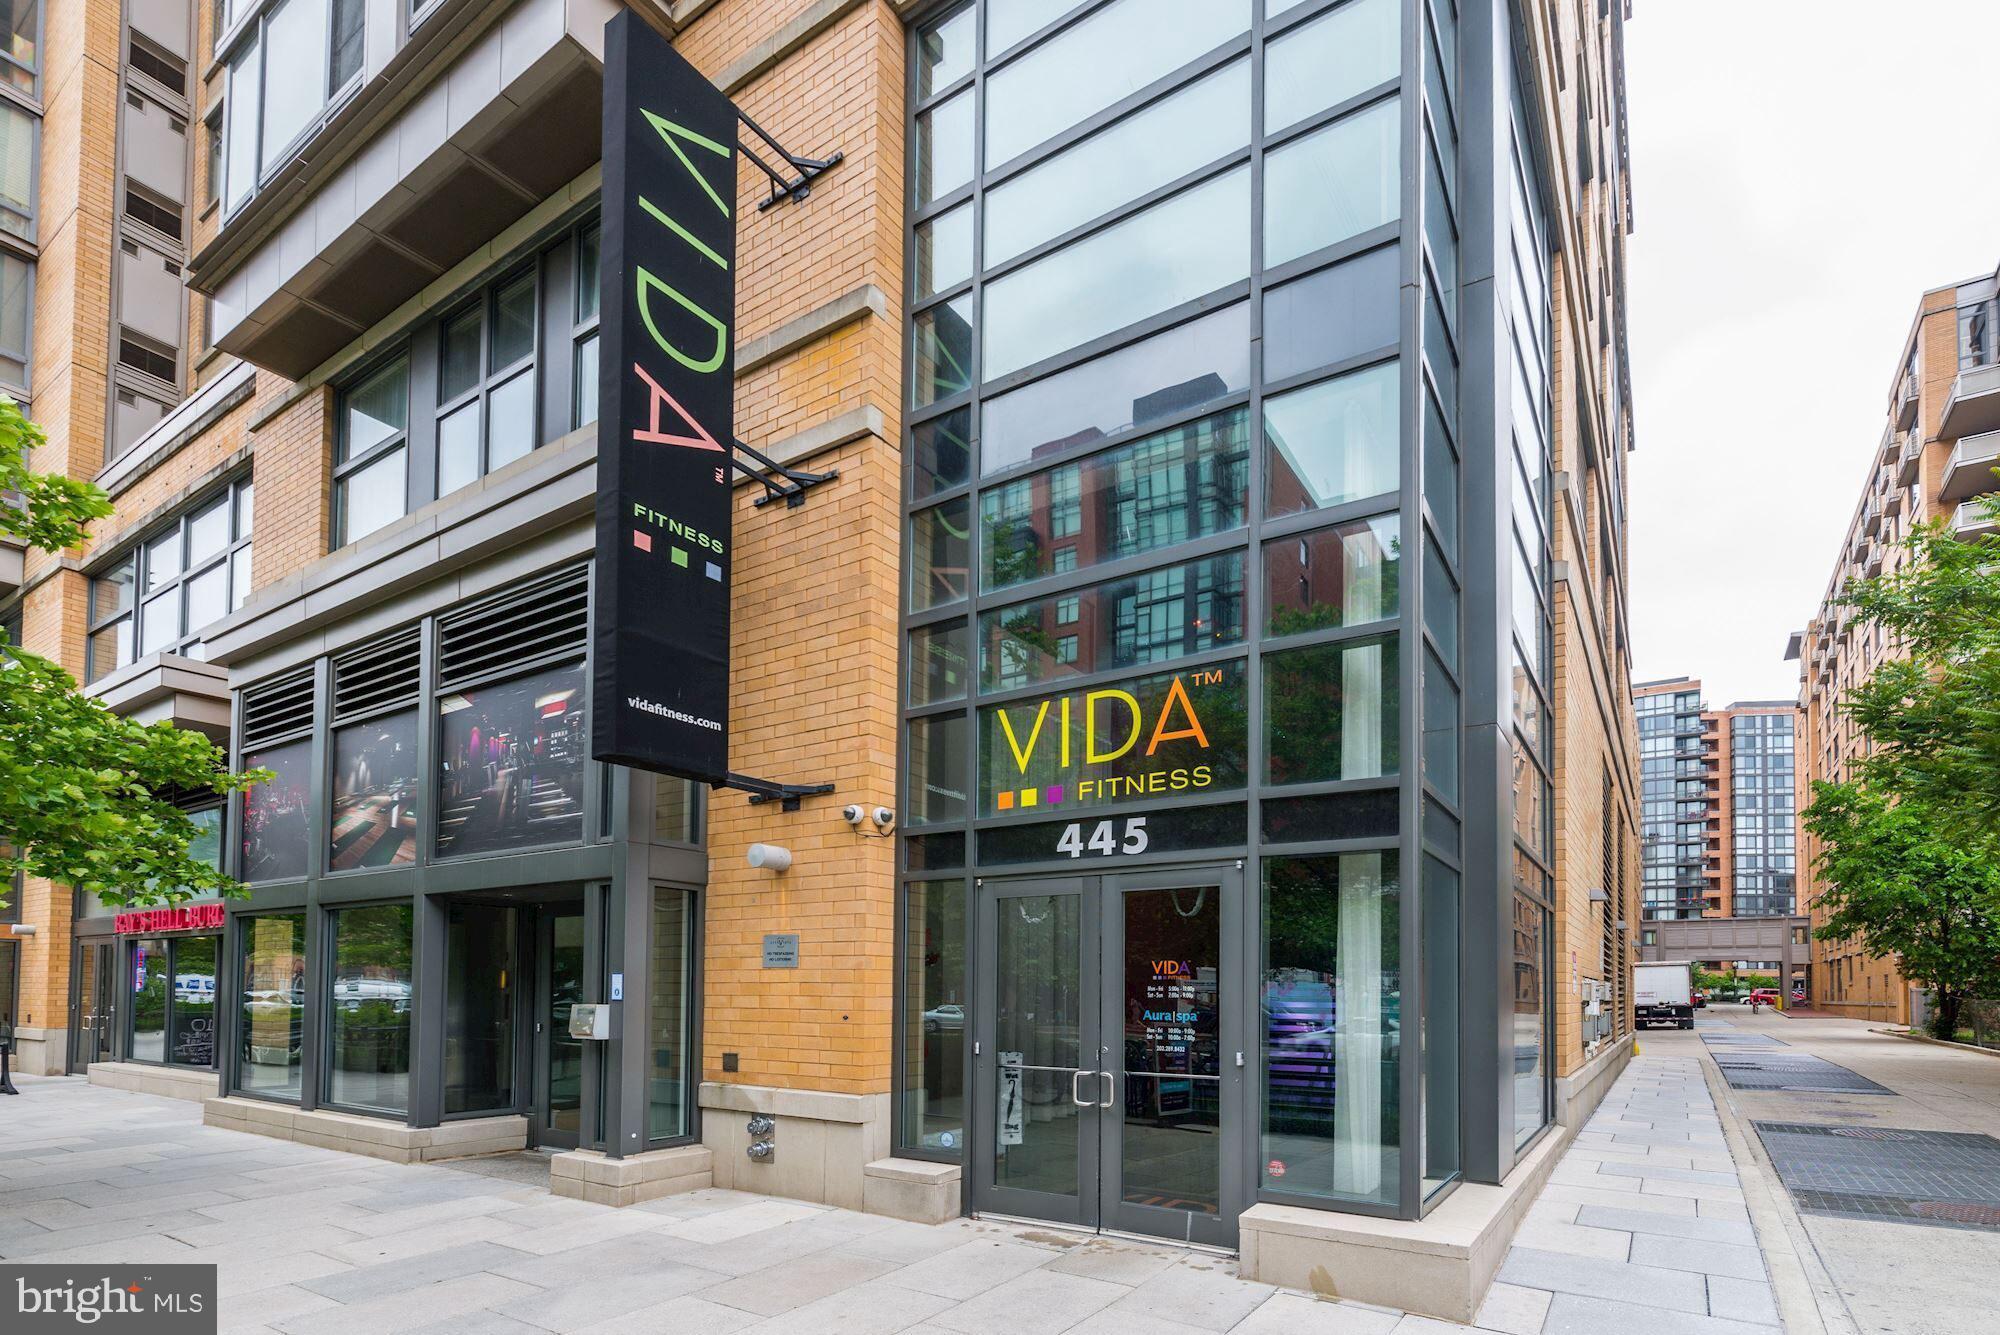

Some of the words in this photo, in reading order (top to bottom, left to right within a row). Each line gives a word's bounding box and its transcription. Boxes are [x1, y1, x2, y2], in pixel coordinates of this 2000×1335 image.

[633, 108, 730, 452] VIDA
[633, 502, 724, 554] FITNESS
[627, 695, 722, 732] vidafitness.com
[997, 675, 1210, 775] VIDA
[1191, 669, 1222, 686] TM
[1078, 765, 1212, 801] FITNESS
[1056, 816, 1149, 858] 445
[151, 908, 183, 930] HELL
[1151, 959, 1191, 974] VIDA
